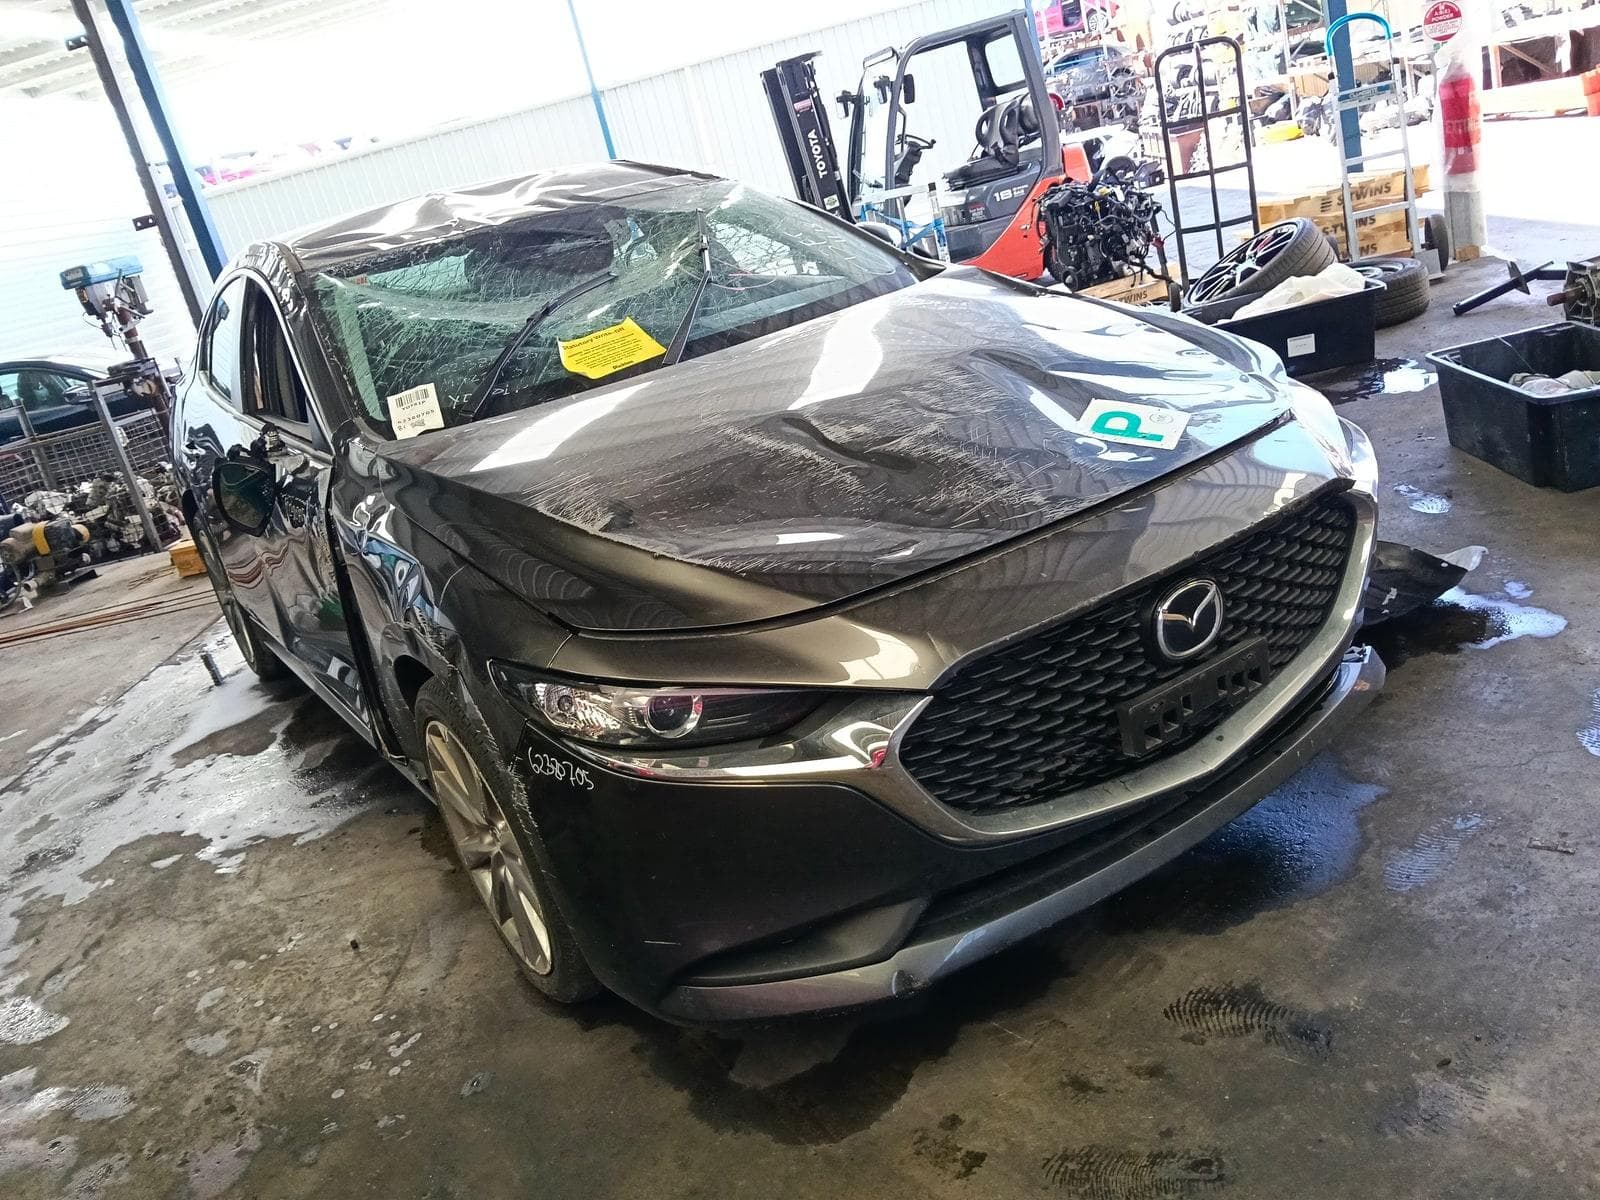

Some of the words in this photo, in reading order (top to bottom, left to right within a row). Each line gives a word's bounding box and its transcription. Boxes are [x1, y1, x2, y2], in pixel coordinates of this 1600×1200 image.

[807, 129, 828, 179] TOYOTA
[993, 188, 1013, 202] 18
[1336, 182, 1392, 207] STWINS
[1091, 411, 1164, 442] P
